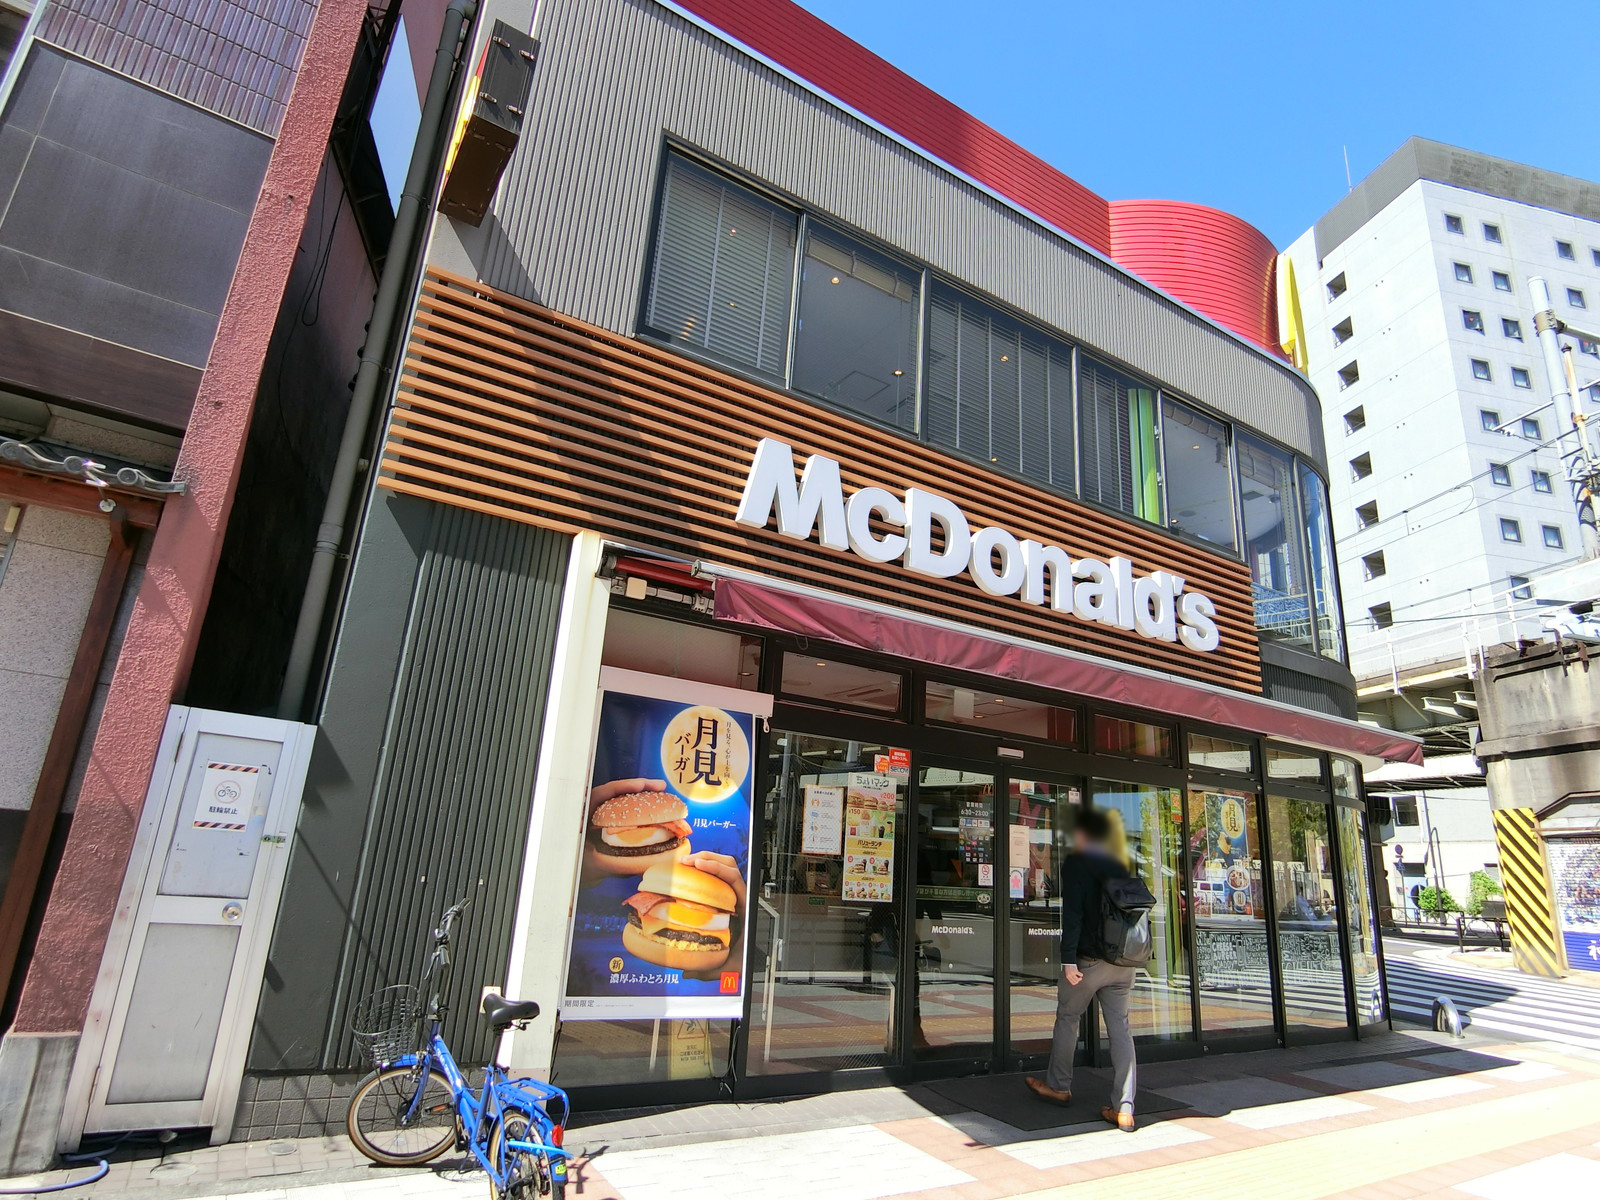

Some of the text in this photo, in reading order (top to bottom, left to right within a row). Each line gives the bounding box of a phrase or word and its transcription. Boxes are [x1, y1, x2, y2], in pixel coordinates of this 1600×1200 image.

[735, 437, 1220, 652] McDonald's
[687, 716, 722, 786] 月見
[673, 732, 691, 784] バーガー
[209, 806, 238, 815] 駐輪禁止
[693, 818, 736, 829] 月見バーガー
[611, 958, 622, 969] 新
[609, 973, 679, 984] 濃厚ふわとろ月見
[564, 1000, 595, 1008] 期間限定
